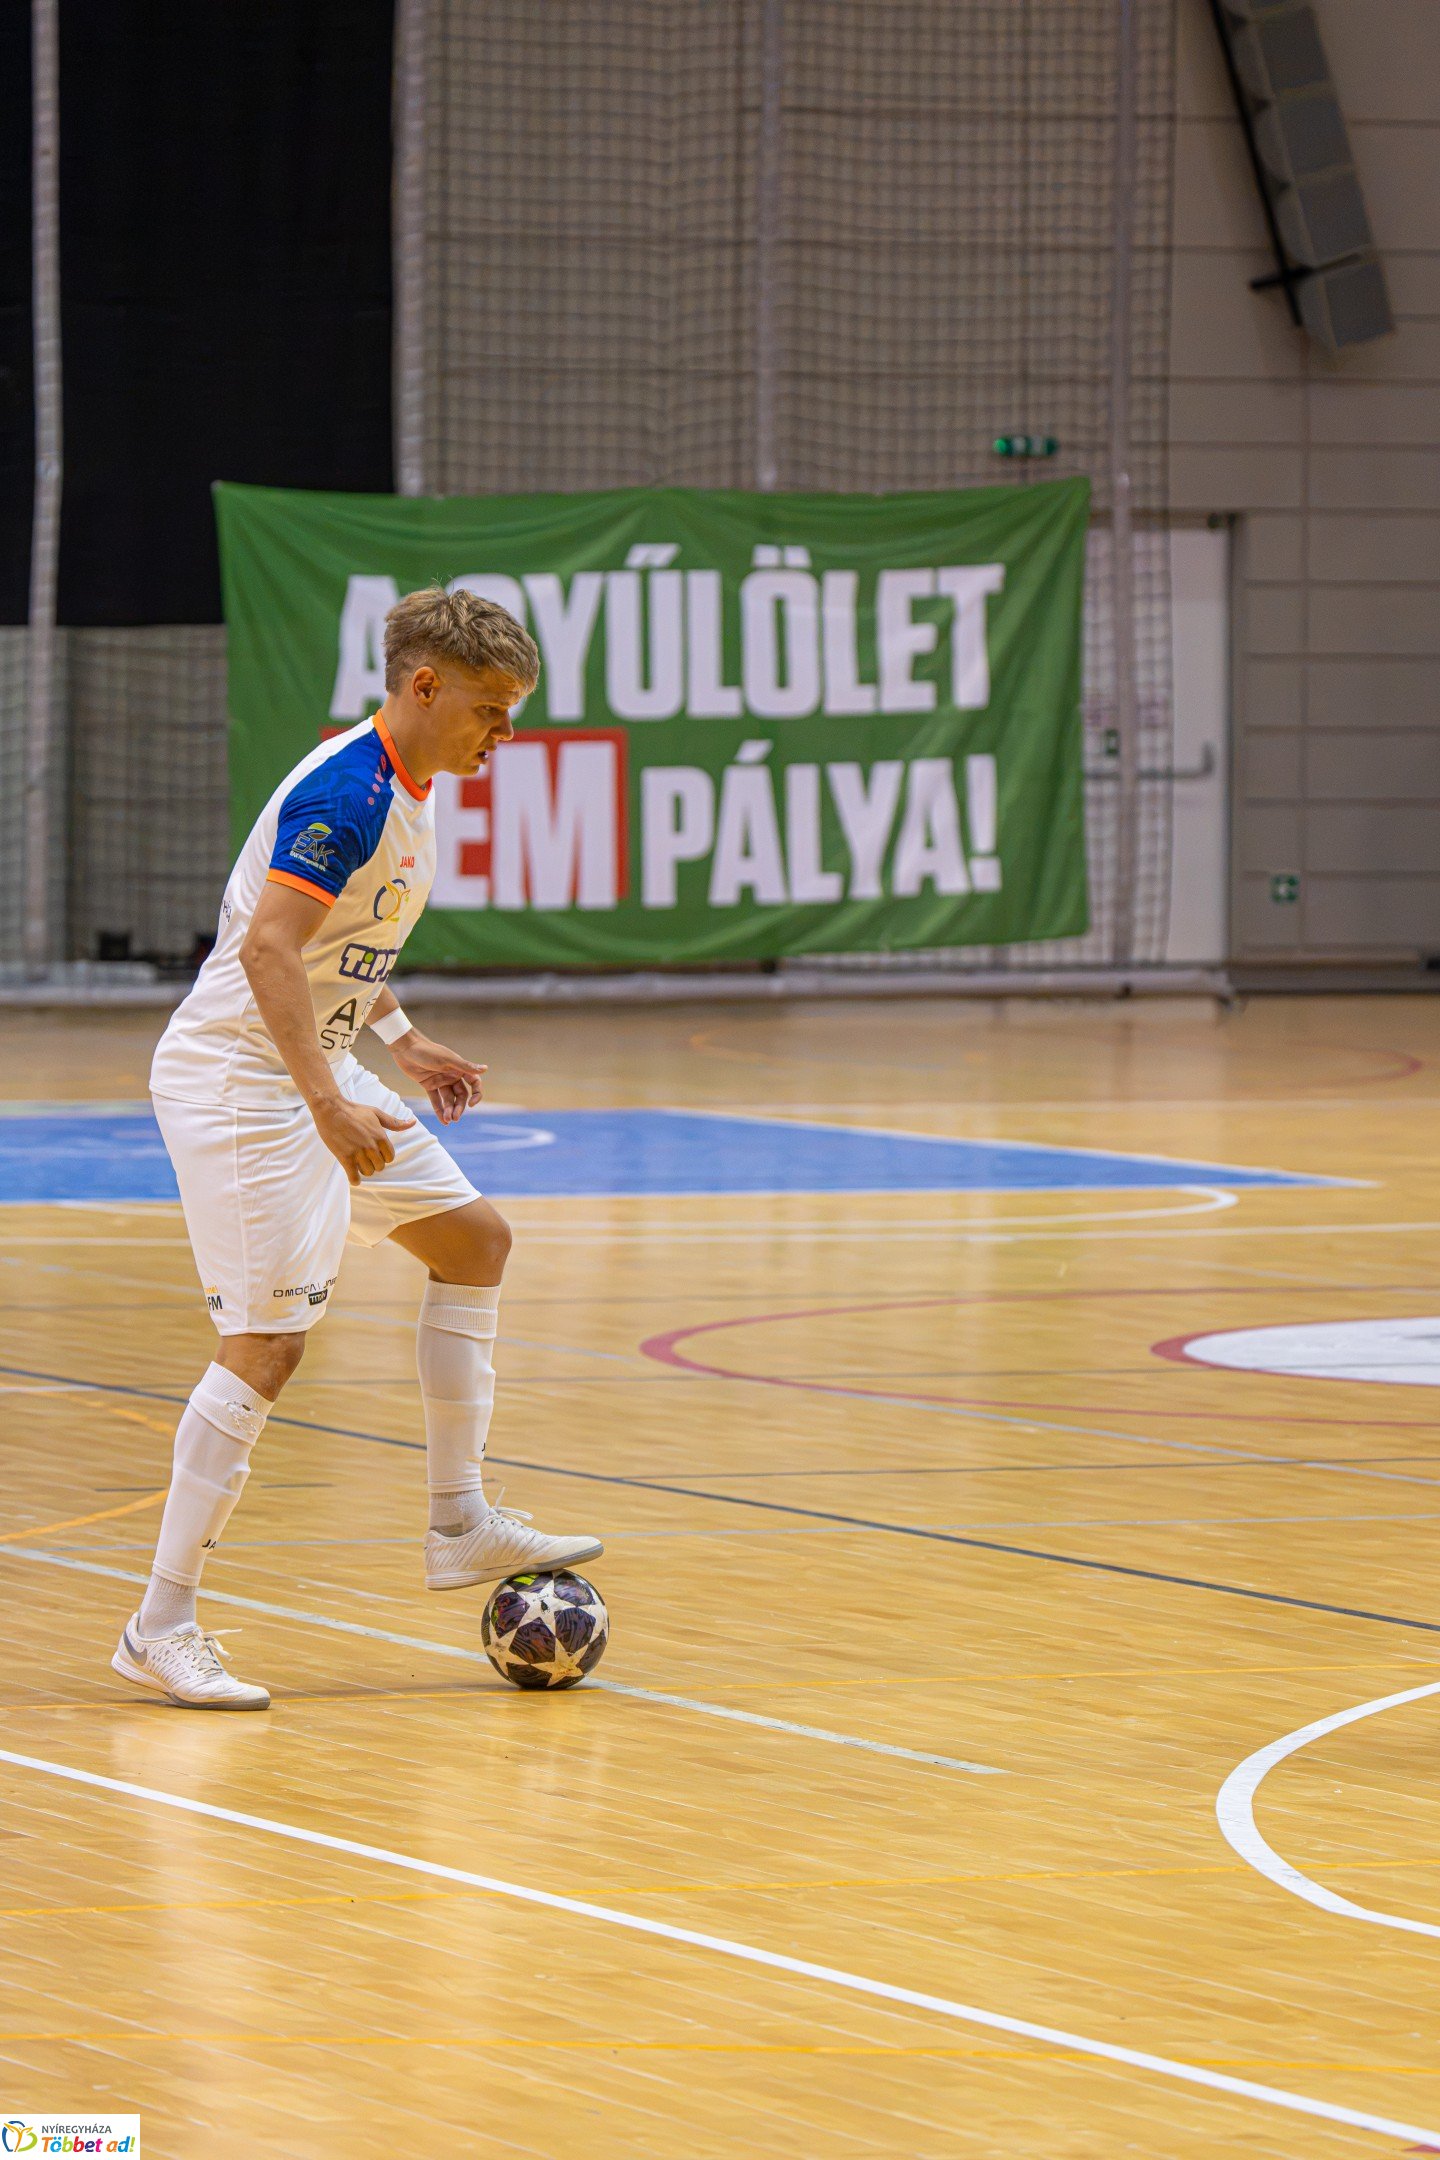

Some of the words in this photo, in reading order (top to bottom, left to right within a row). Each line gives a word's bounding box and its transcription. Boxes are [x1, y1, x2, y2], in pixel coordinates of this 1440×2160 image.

[399, 856, 415, 868] JAKO
[430, 740, 618, 911] EM
[641, 739, 1002, 908] PÁLYA!
